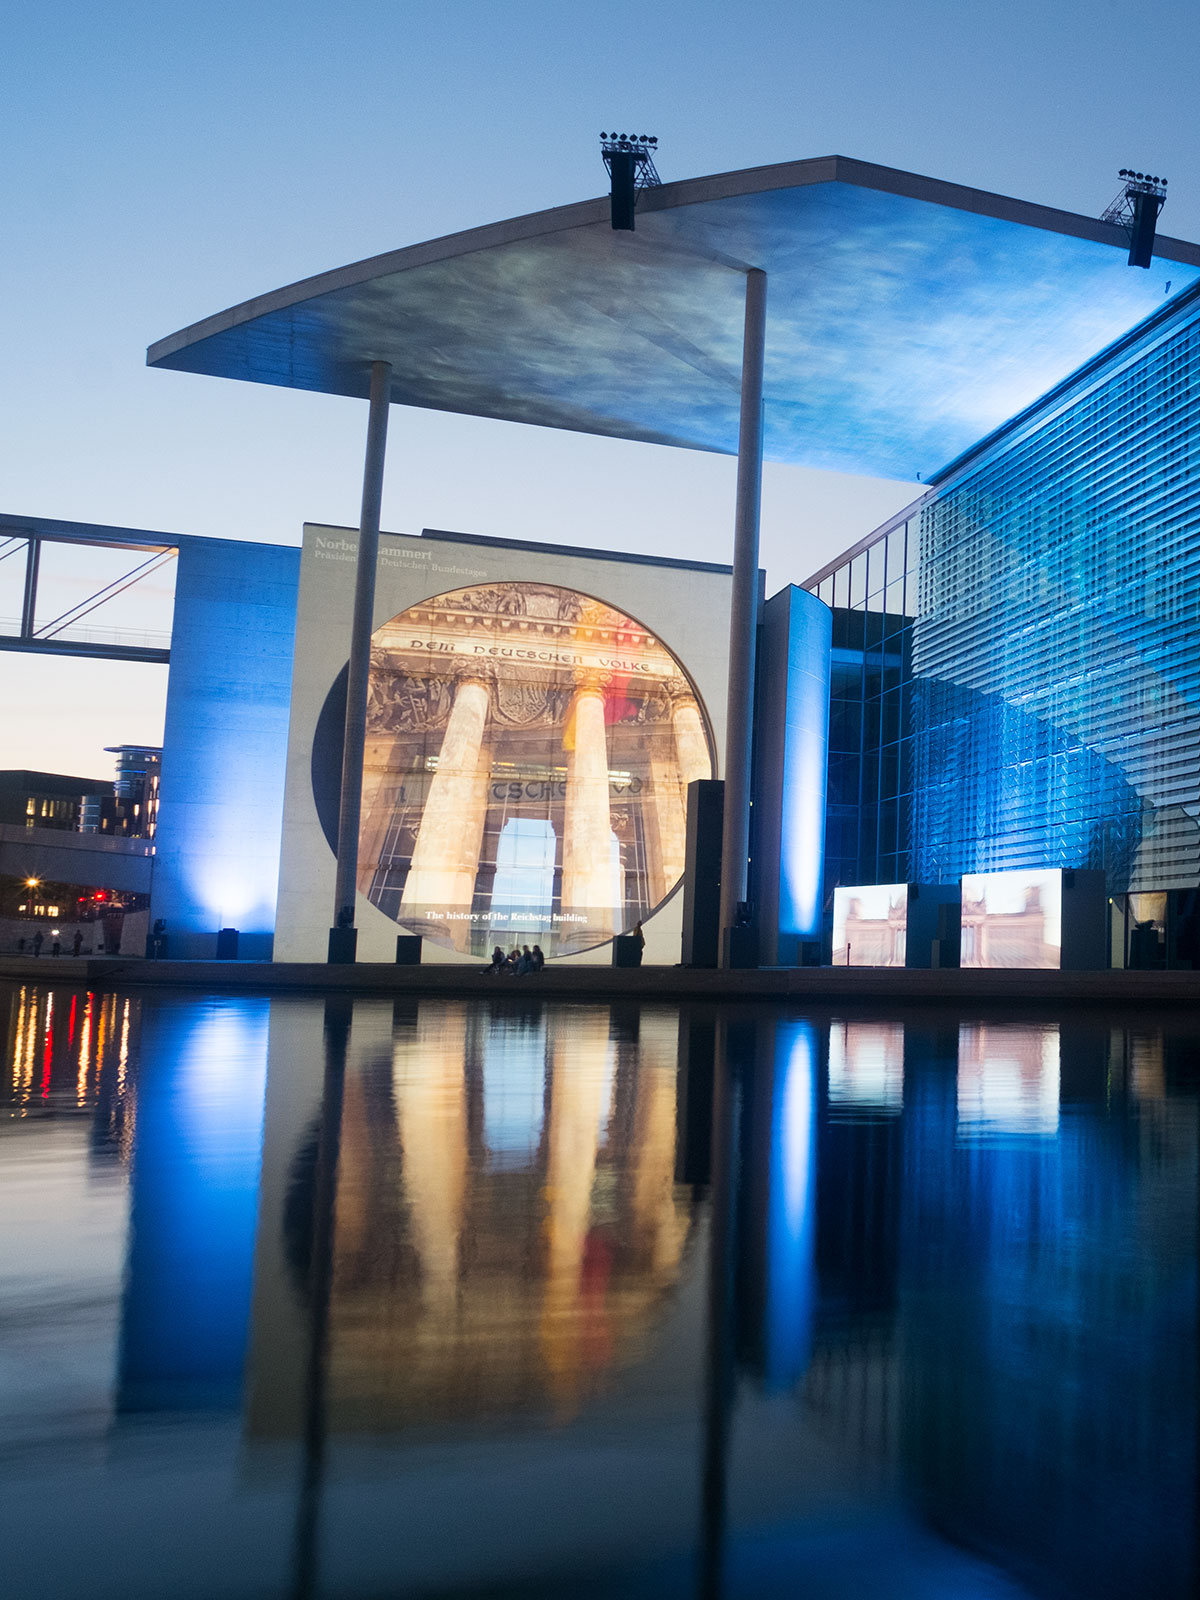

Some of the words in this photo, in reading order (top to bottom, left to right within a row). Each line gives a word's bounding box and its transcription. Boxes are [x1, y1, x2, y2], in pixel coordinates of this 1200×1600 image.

[315, 536, 357, 552] Norbe
[377, 547, 432, 561] ammert
[314, 550, 357, 562] Präsiden
[431, 563, 488, 578] Bundestages
[410, 639, 456, 651] DEM
[473, 645, 583, 664] DEUTSCHEN
[599, 658, 650, 672] VOLKE
[425, 911, 444, 920] The
[446, 911, 480, 923] history
[482, 911, 493, 921] of
[494, 911, 509, 921] the
[511, 911, 552, 923] Reichstag
[552, 912, 588, 924] building
